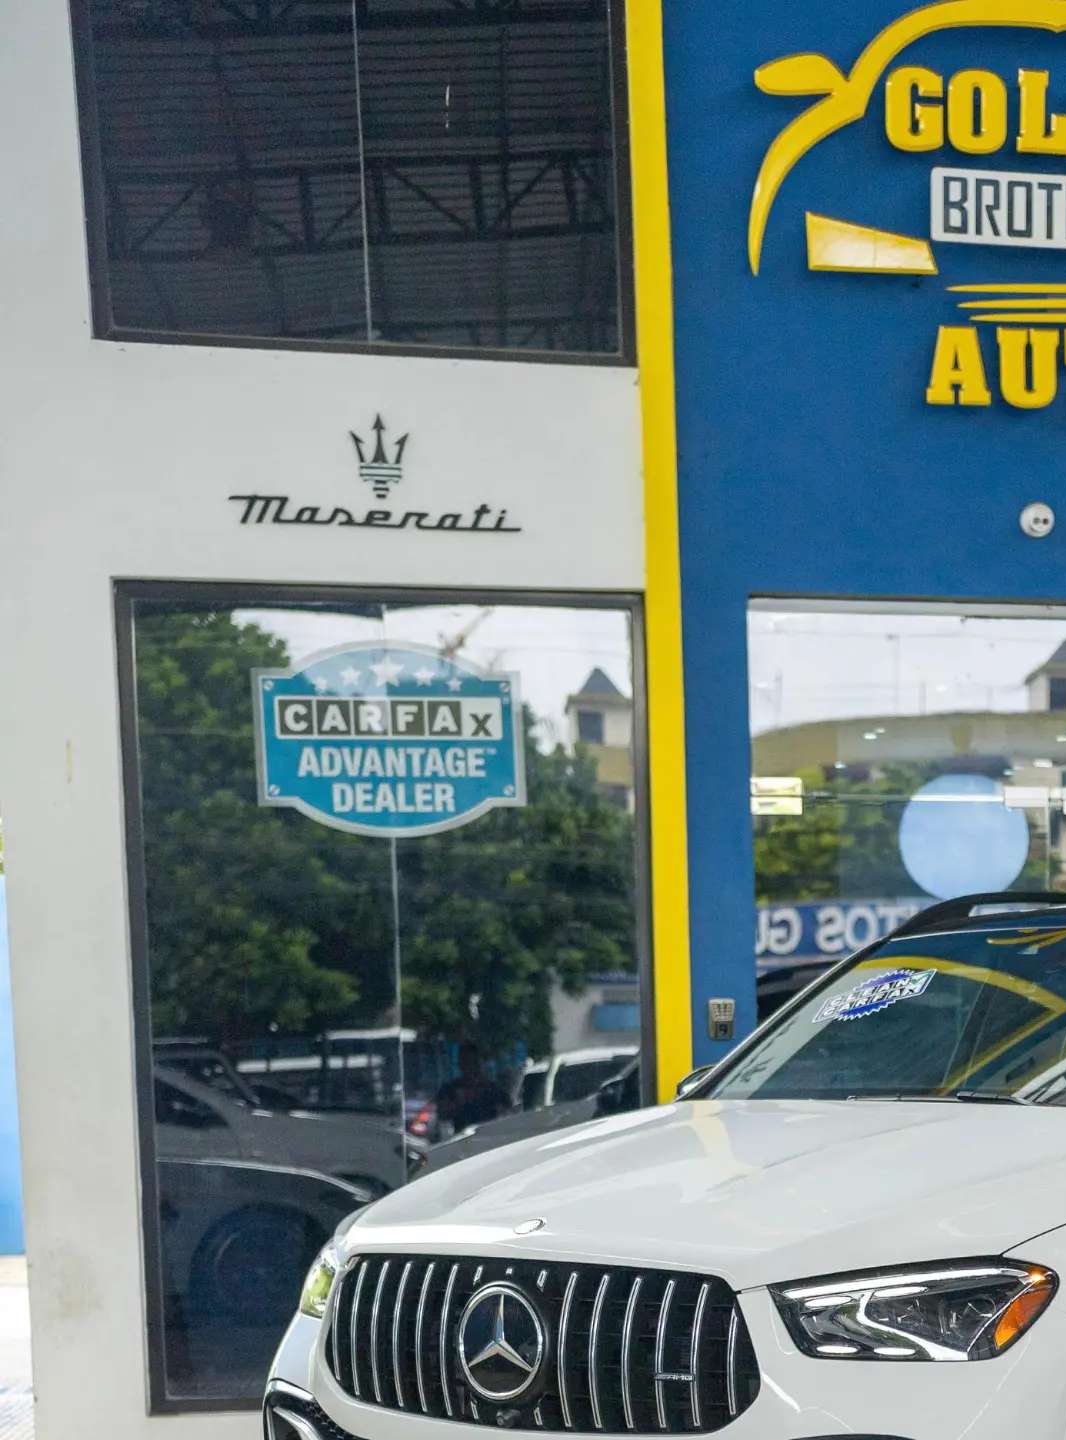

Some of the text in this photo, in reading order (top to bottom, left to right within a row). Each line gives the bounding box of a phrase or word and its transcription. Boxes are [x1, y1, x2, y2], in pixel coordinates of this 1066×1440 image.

[229, 494, 522, 533] Maserati
[283, 703, 493, 737] CARFAX
[298, 747, 487, 778] ADVANTAGE
[332, 783, 456, 813] DEALER
